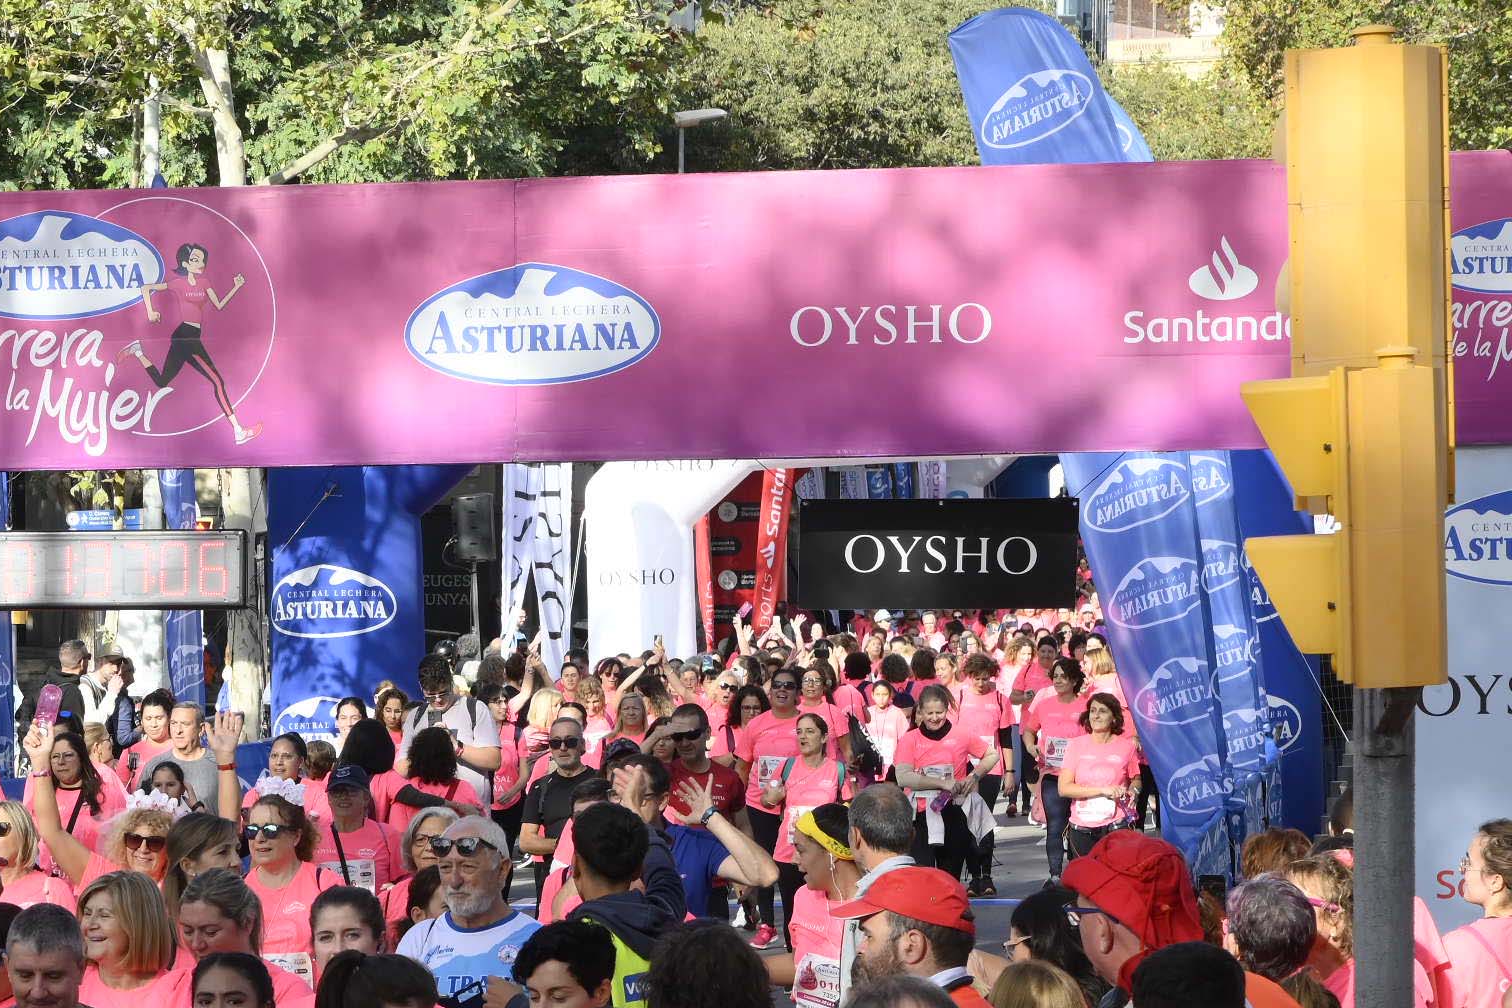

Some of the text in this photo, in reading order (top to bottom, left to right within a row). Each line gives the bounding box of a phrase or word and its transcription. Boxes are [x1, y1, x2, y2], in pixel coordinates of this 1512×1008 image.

[67, 246, 139, 258] LECHERA
[464, 303, 632, 319] CENTRAL LECHERA
[789, 302, 992, 347] OYSHO
[1451, 299, 1512, 329] arre
[425, 310, 641, 354] ASTURIANA
[1123, 309, 1292, 344] Santand
[1474, 329, 1491, 357] la
[5, 371, 30, 411] la
[25, 364, 175, 457] Mujer
[843, 533, 1039, 576] OYSHO
[598, 567, 675, 585] OYSHO
[274, 593, 388, 622] ASTURIANA
[287, 589, 383, 599] CENTRAL LECHERA
[288, 721, 330, 730] CENTRAL
[494, 776, 511, 784] SAL
